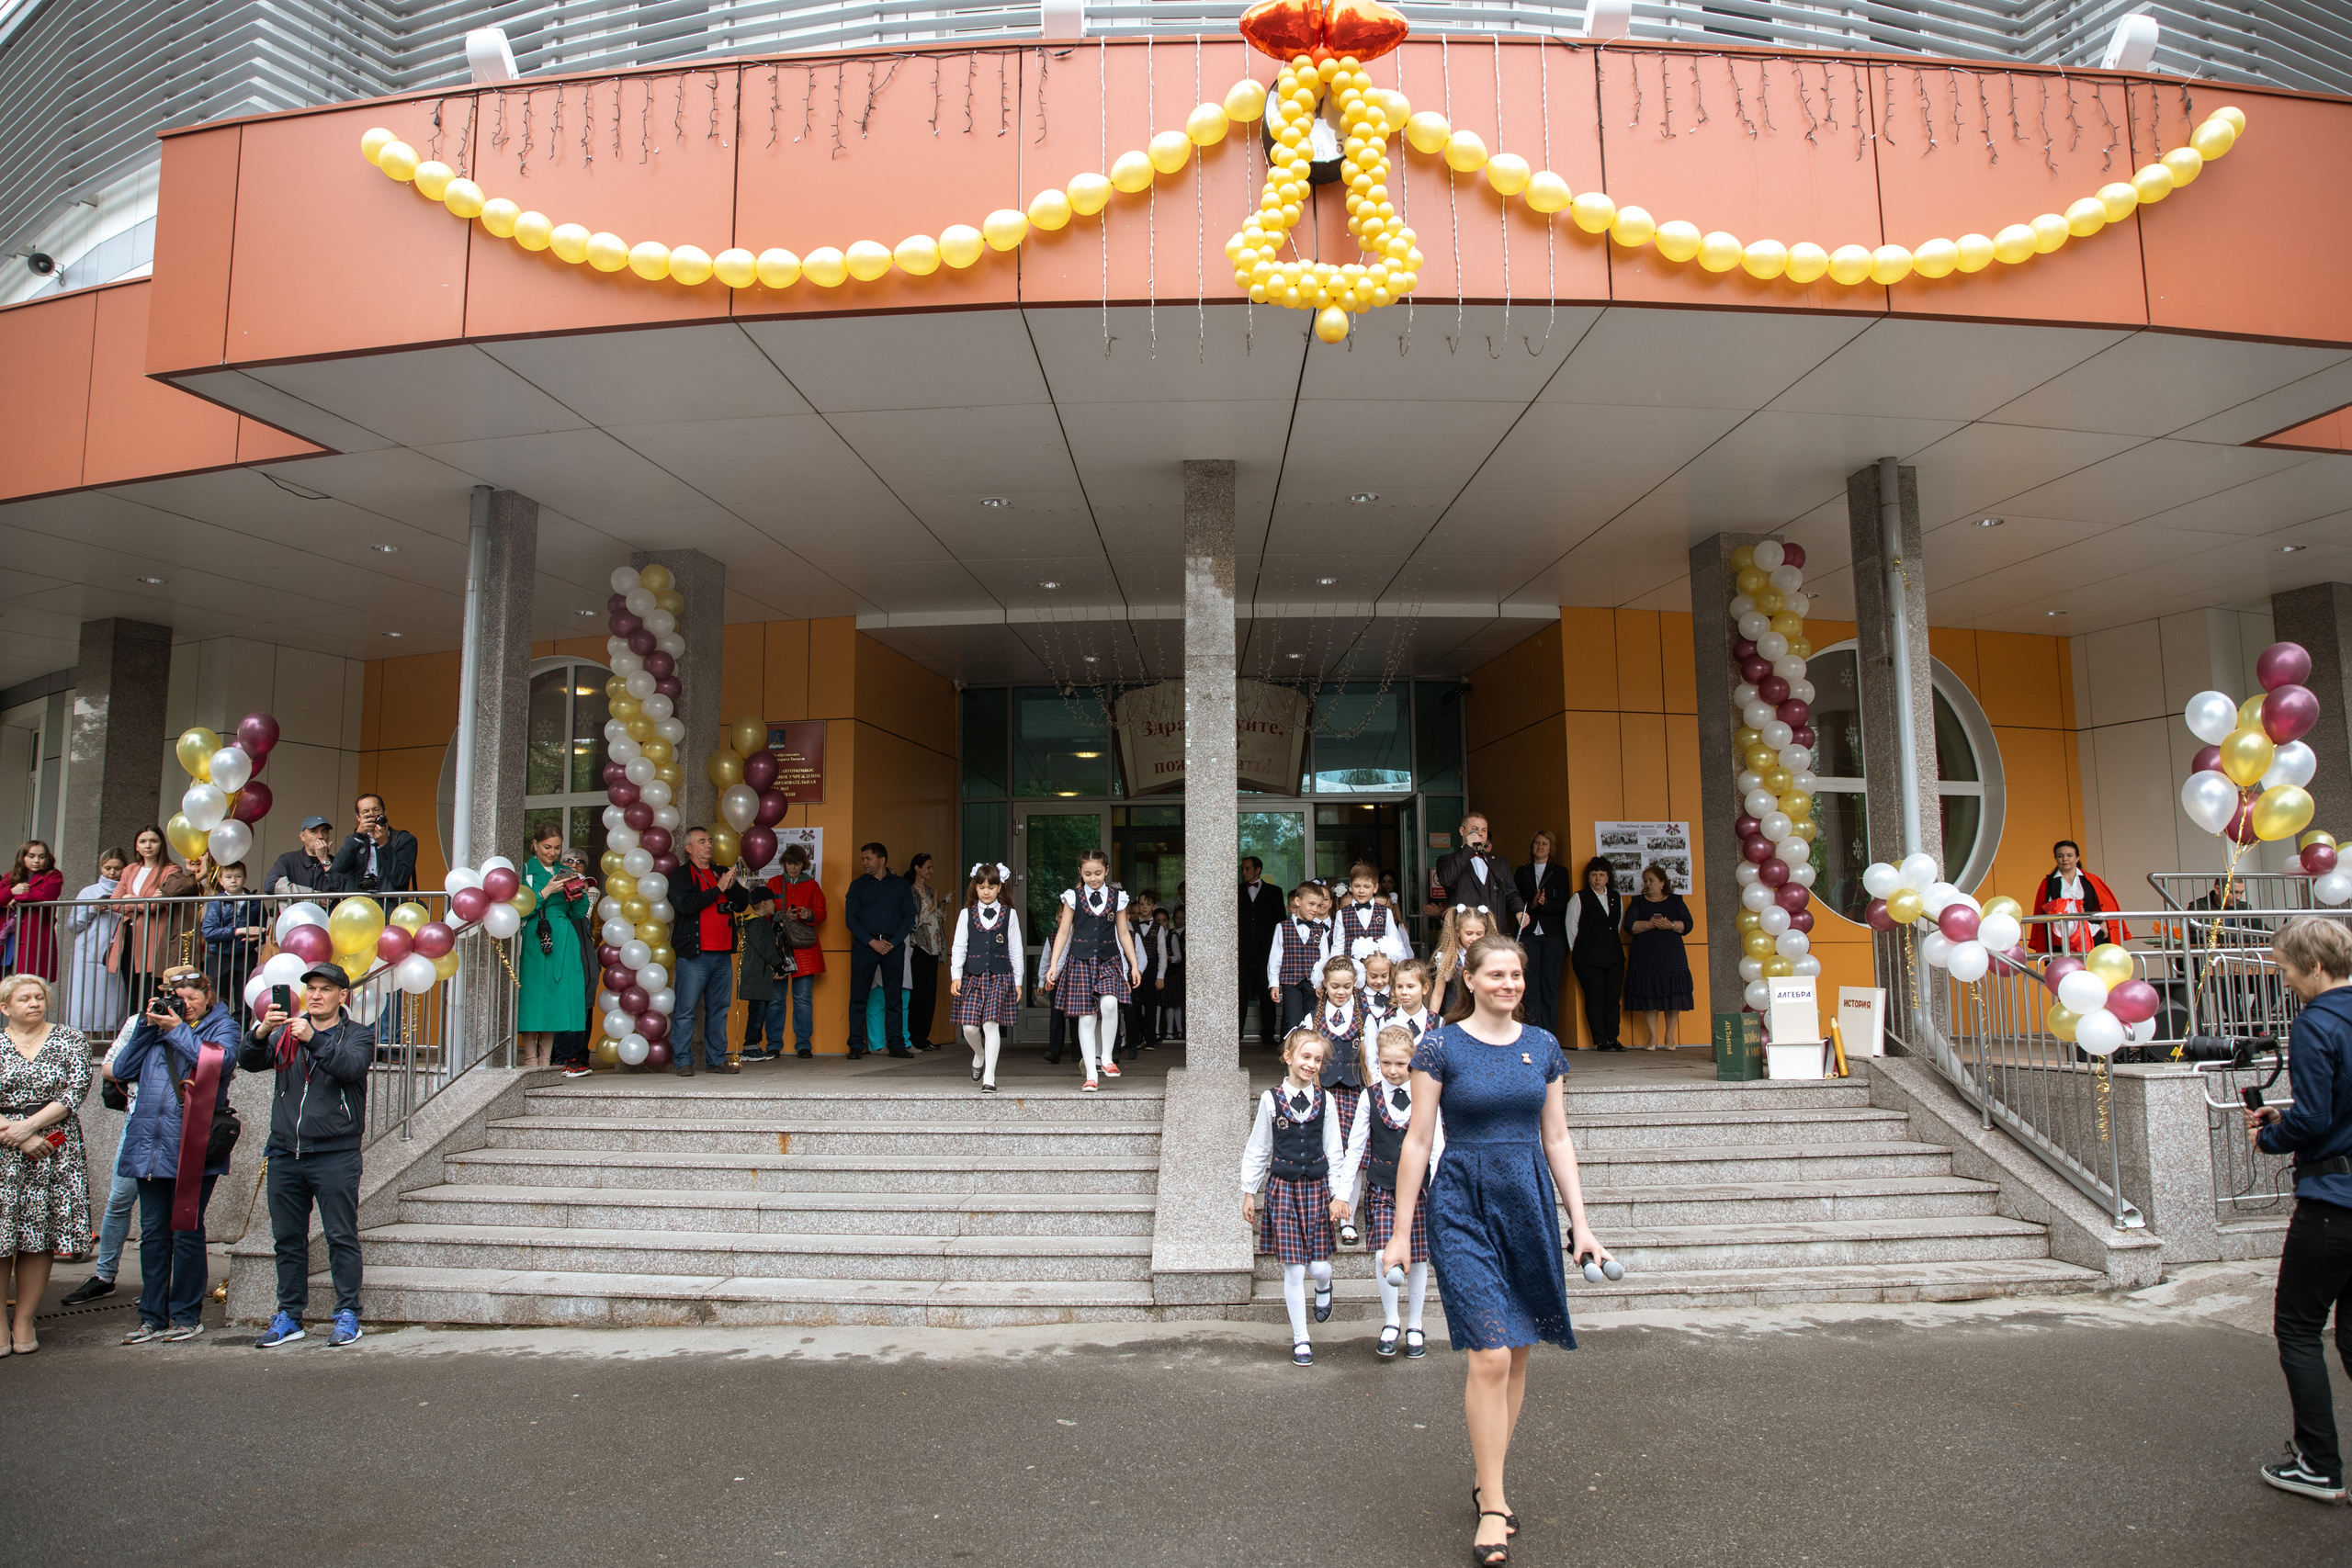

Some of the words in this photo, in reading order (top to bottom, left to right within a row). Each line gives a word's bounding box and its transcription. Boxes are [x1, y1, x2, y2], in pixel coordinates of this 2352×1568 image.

[1317, 144, 1326, 159] 6
[1141, 719, 1283, 739] Здрауйте,
[1154, 758, 1272, 774] пожать!
[1777, 990, 1811, 998] АЛГЕБРА
[1843, 998, 1871, 1010] ИСТОРИЯ
